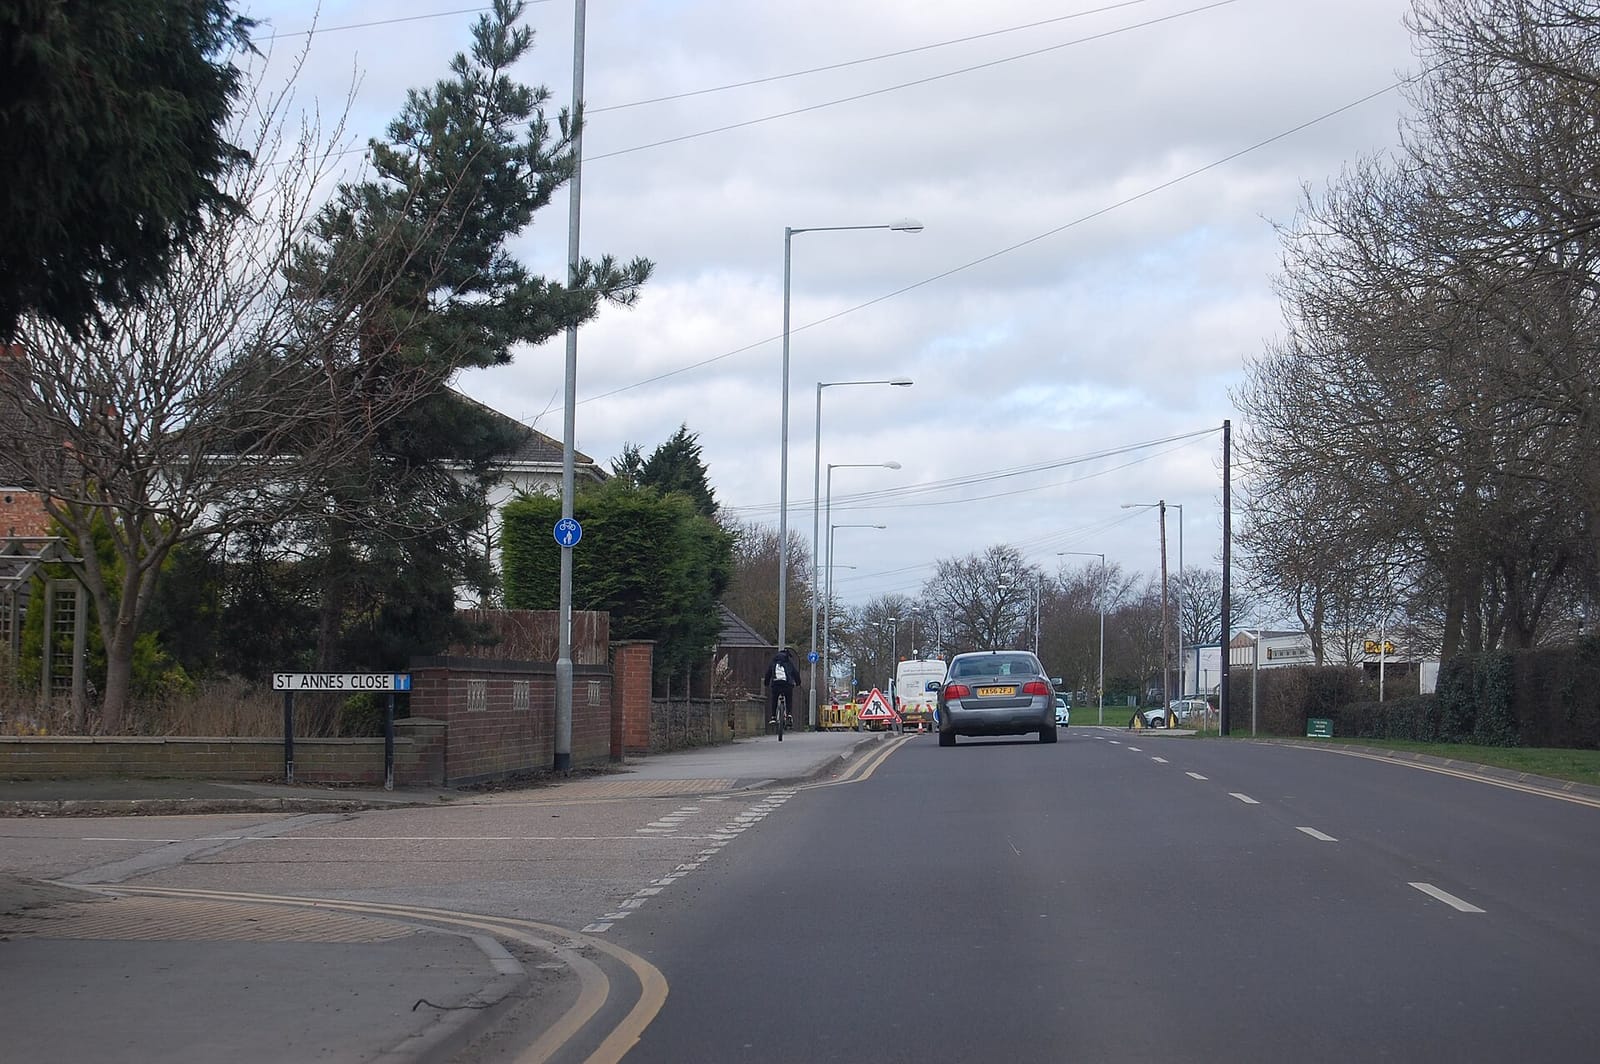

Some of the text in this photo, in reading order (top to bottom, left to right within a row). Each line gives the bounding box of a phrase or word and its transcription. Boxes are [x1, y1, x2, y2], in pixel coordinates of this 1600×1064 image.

[277, 675, 389, 688] ST ANNES CLOSE
